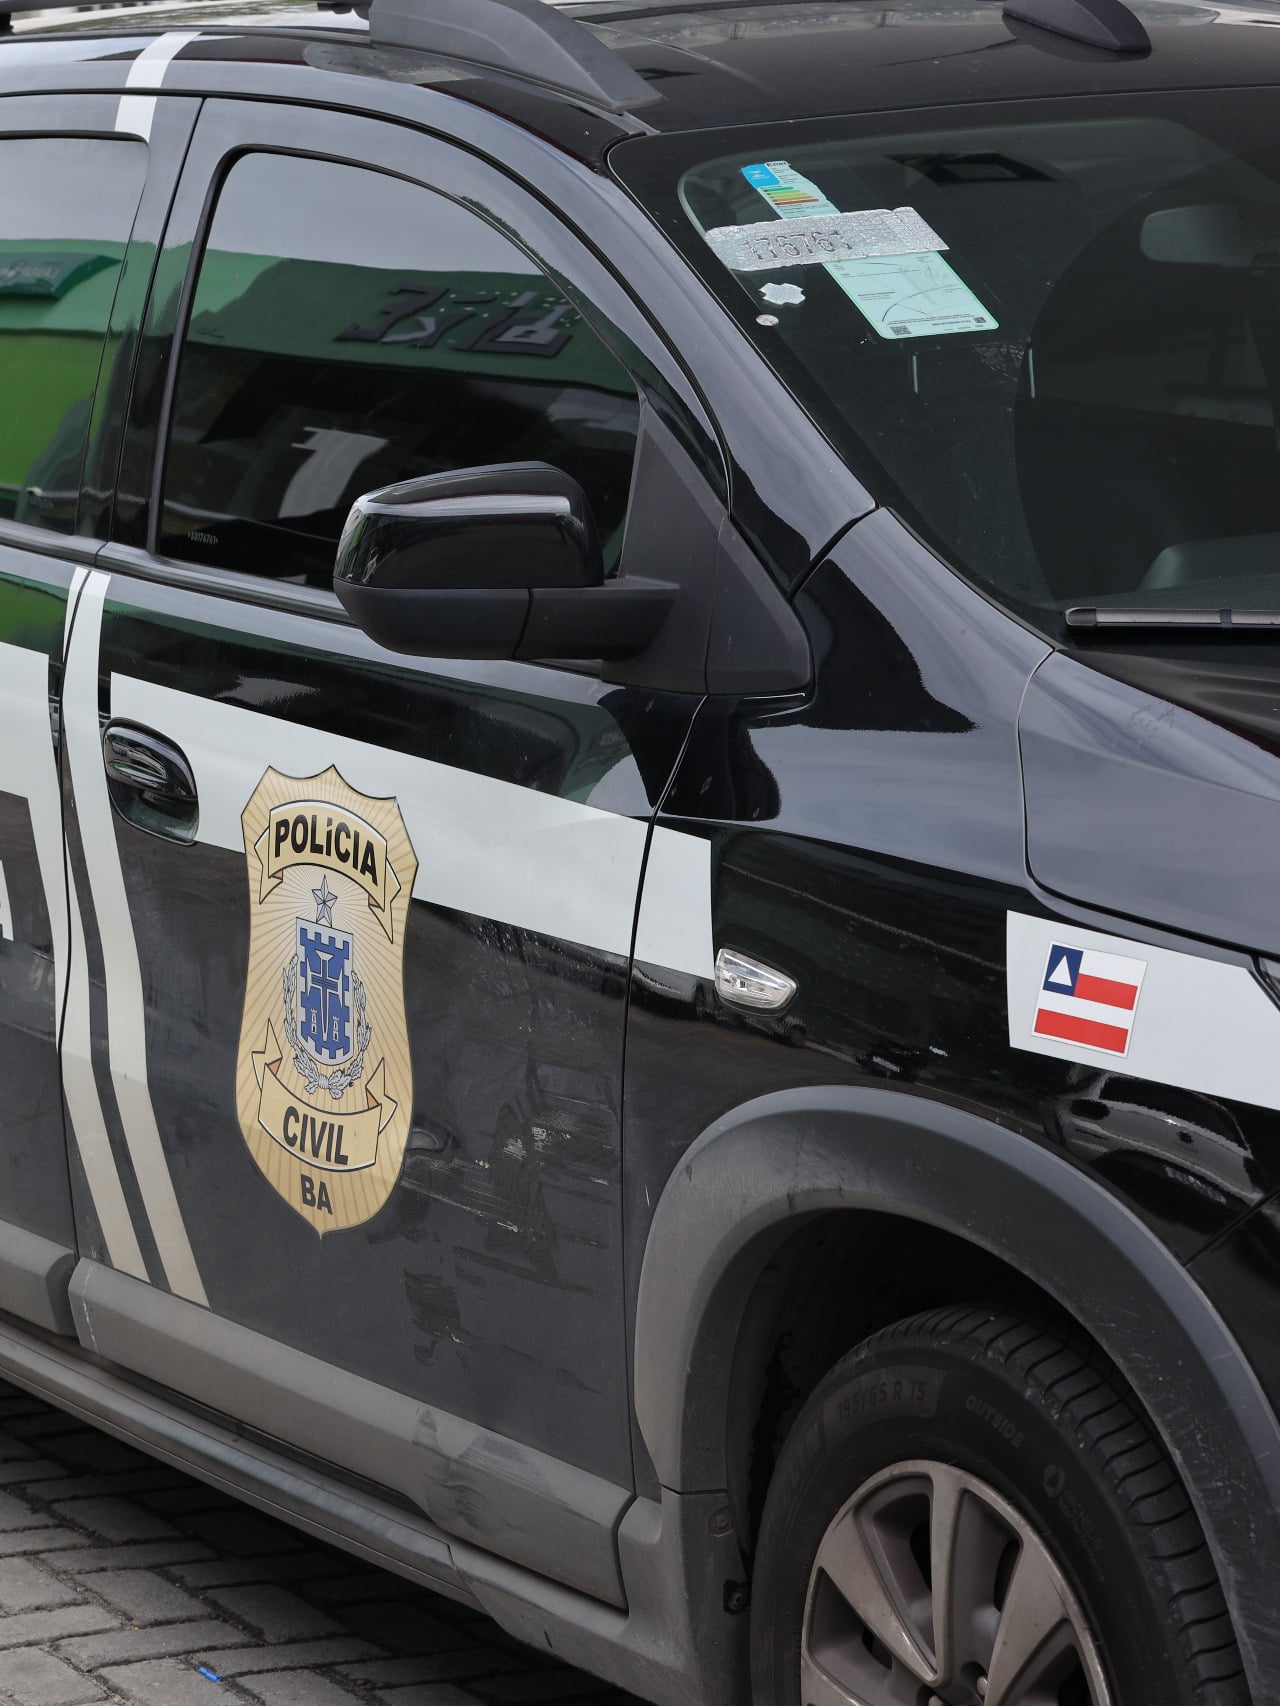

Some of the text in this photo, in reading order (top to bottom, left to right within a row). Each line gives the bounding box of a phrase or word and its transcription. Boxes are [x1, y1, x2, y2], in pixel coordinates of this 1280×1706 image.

[274, 812, 380, 887] POLÍCIA
[282, 1104, 350, 1166] CIVIL
[300, 1173, 334, 1216] BA
[892, 1380, 904, 1402] R
[965, 1393, 1027, 1449] OUTSIDE
